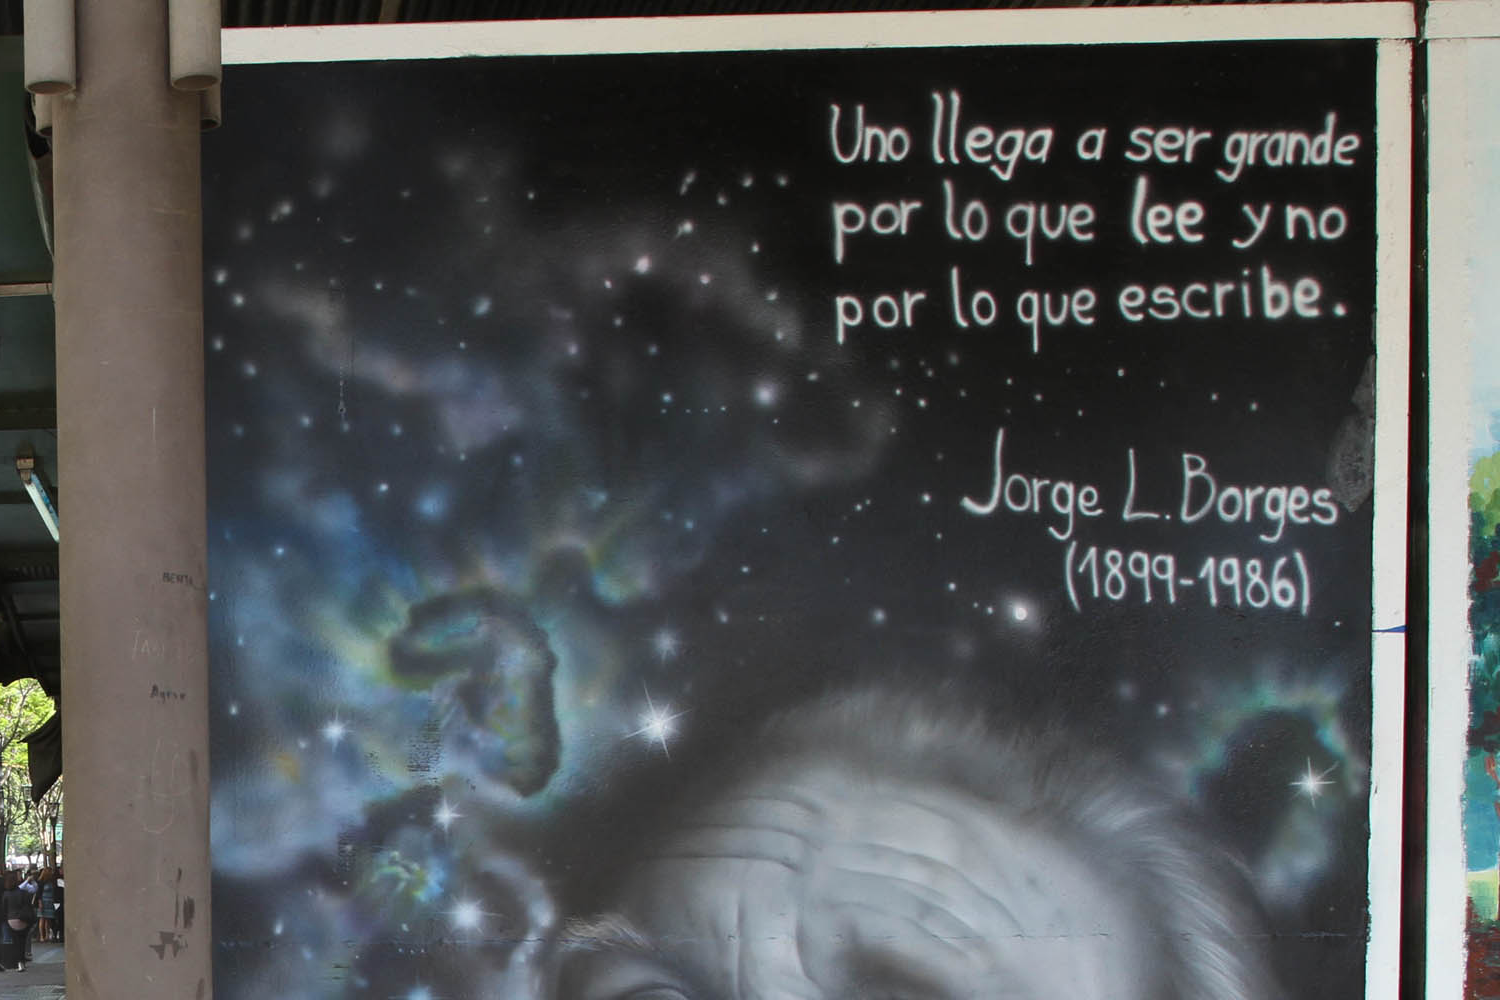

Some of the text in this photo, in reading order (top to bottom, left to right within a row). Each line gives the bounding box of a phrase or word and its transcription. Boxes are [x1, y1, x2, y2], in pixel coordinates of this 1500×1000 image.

[830, 90, 1360, 183] Uno llega a ser grande
[832, 175, 1347, 266] por lo que lee y no
[835, 265, 1347, 353] por lo que escribe.
[961, 428, 1104, 541] Jorge
[1180, 453, 1338, 543] Borges
[1065, 540, 1311, 615] (1899-1986)
